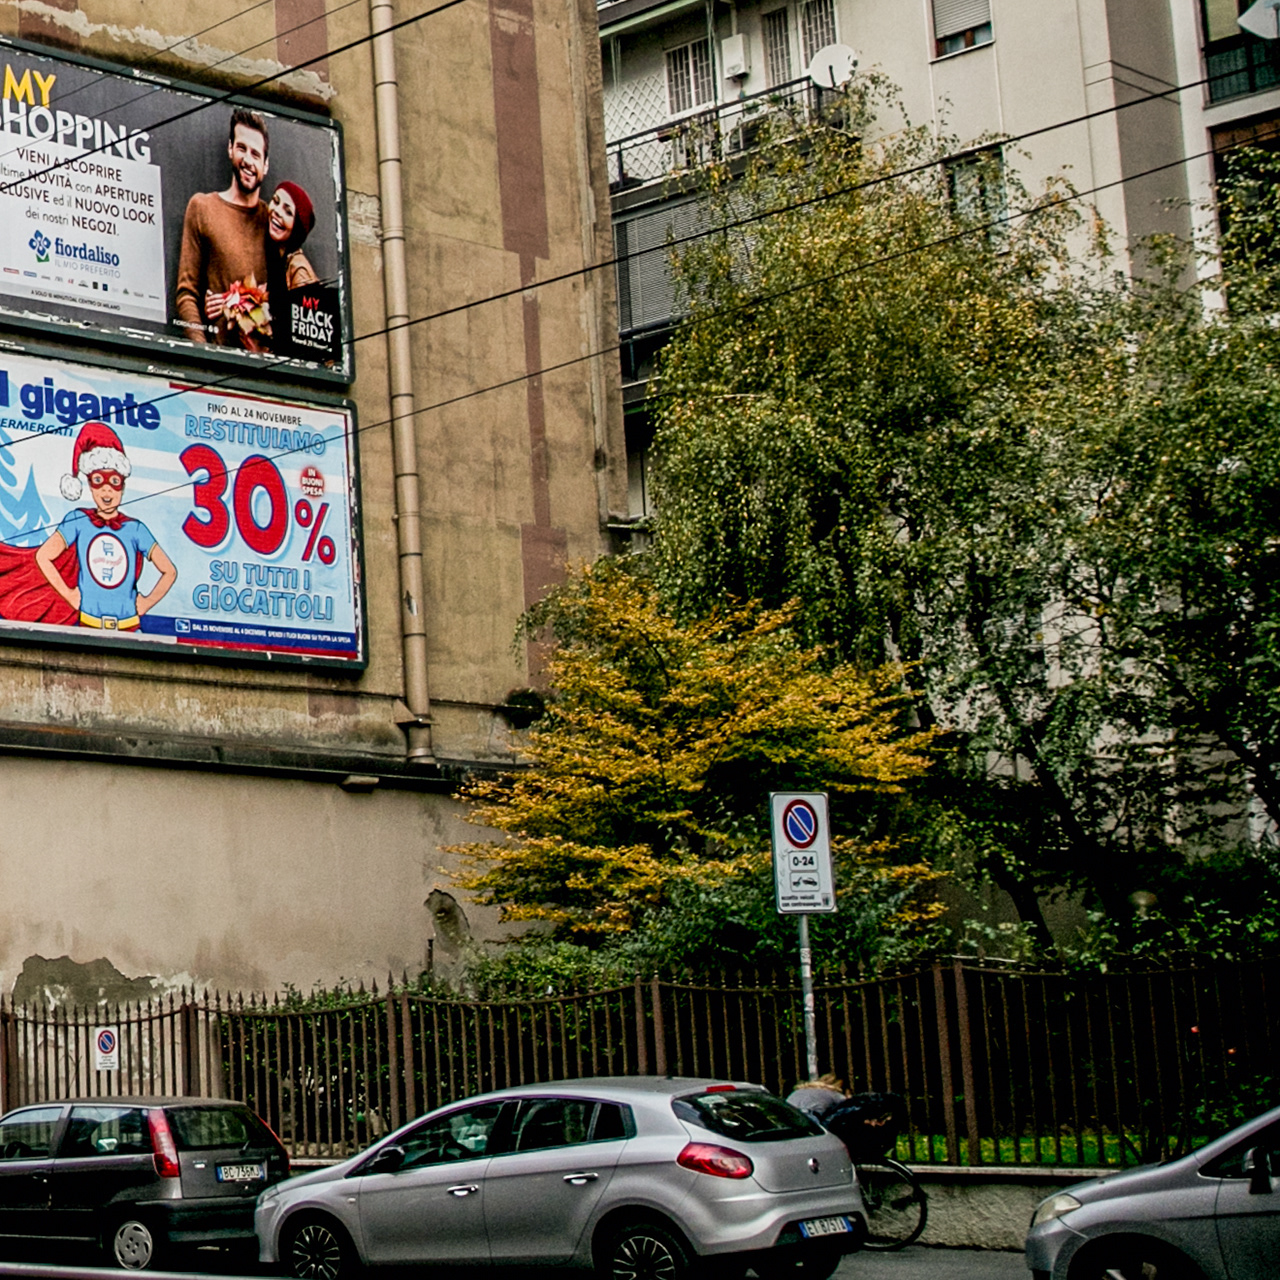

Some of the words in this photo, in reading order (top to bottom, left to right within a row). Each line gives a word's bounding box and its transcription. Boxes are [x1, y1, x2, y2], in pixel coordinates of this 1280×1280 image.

[3, 63, 57, 109] MY
[16, 147, 50, 166] VIENI
[53, 156, 61, 169] A
[63, 157, 123, 182] SCOPRIRE
[27, 168, 73, 189] NOVITÀ
[75, 183, 92, 193] con
[95, 184, 155, 208] APERTURE
[25, 206, 40, 220] dei
[43, 212, 69, 226] nostri
[72, 215, 120, 237] NEGOZI.
[52, 195, 65, 206] ed
[66, 196, 72, 207] il
[75, 197, 120, 218] NUOVO
[123, 207, 156, 226] LOOK
[55, 237, 120, 267] fiordaliso
[55, 259, 61, 268] IL
[63, 260, 79, 271] MIO
[80, 263, 121, 279] PREFERITO
[291, 303, 334, 329] BLACK
[302, 295, 320, 311] MY
[291, 320, 334, 343] FRIDAY
[20, 376, 161, 431] gigante
[207, 402, 228, 415] FINO
[230, 406, 242, 417] AL
[243, 408, 254, 418] 24
[256, 411, 302, 427] NOVEMBRE
[184, 414, 327, 456] RESTITUIAMO
[301, 476, 323, 487] BUONI
[307, 468, 316, 477] IN
[301, 484, 324, 497] SPESA
[209, 560, 238, 584] SU
[243, 563, 298, 590] TUTTI
[303, 569, 310, 591] I
[192, 583, 333, 621] GIOCATTOLI
[792, 856, 815, 866] 0-24
[223, 1166, 235, 1179] BC
